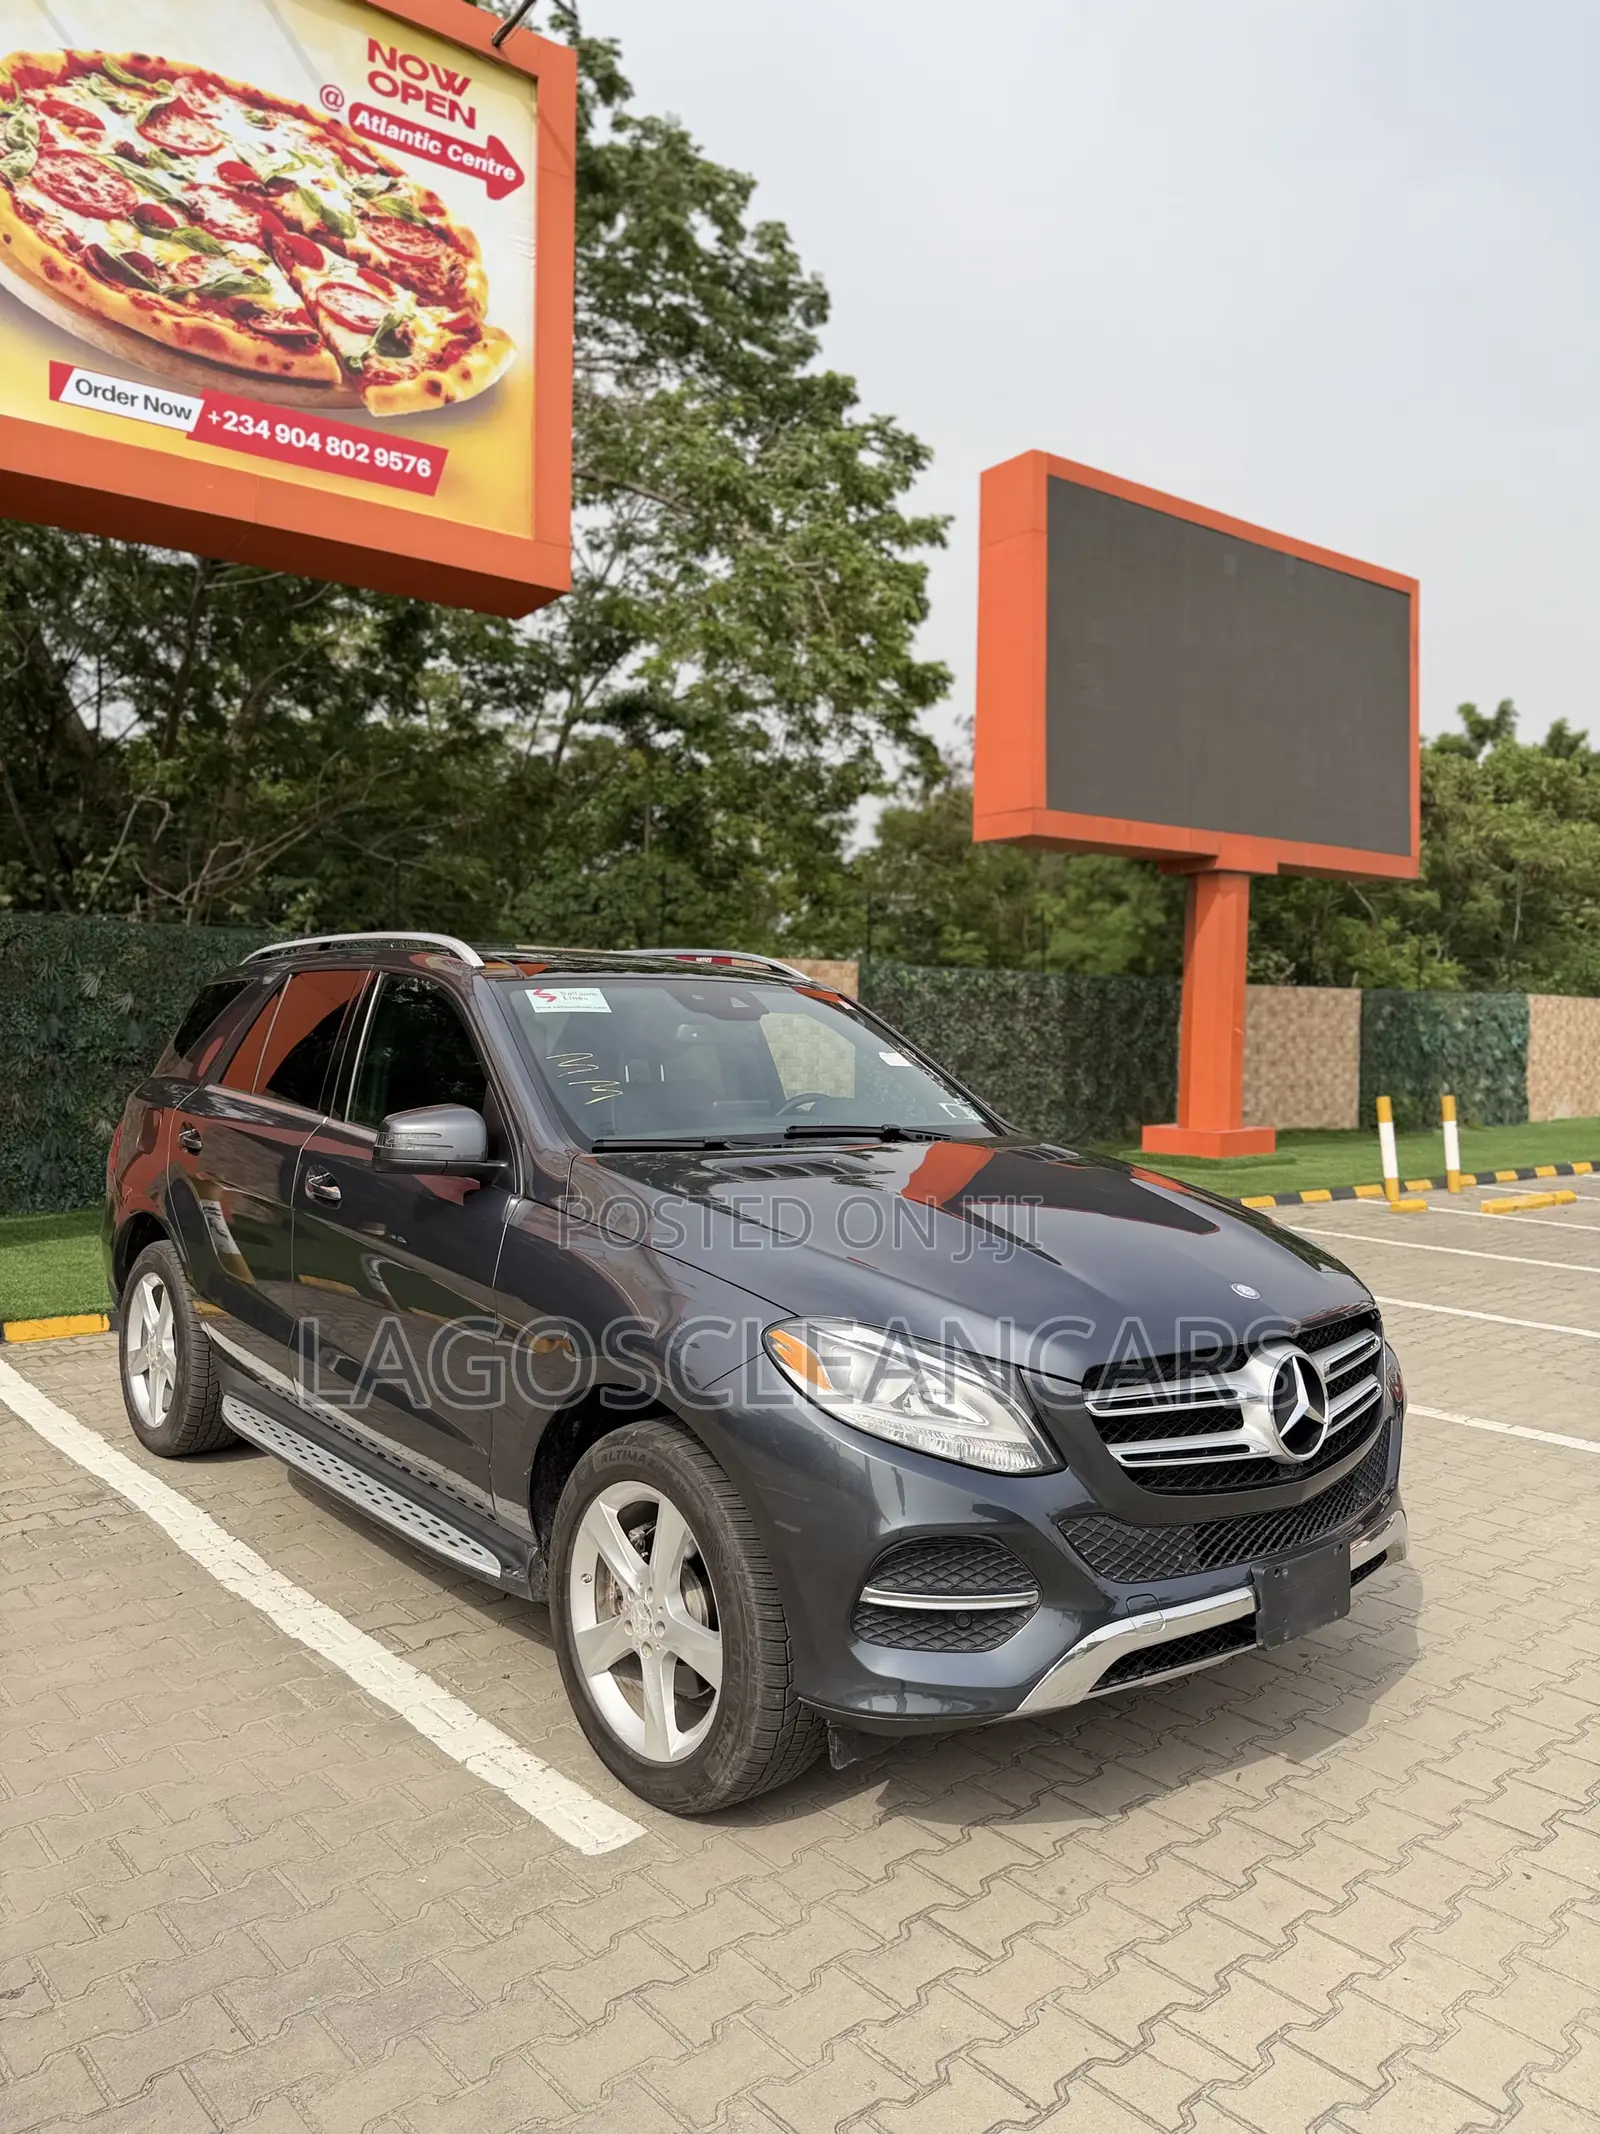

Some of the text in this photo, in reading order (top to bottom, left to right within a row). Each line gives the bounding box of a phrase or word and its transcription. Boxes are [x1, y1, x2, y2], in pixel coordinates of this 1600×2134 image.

[368, 38, 471, 97] NOW
[319, 84, 345, 112] @
[368, 70, 476, 129] OPEN
[354, 110, 516, 182] Atlantic Centre
[75, 378, 193, 422] Order Now
[207, 409, 432, 478] +234 904 802 9576
[602, 1449, 657, 1468] ALTIMAX
